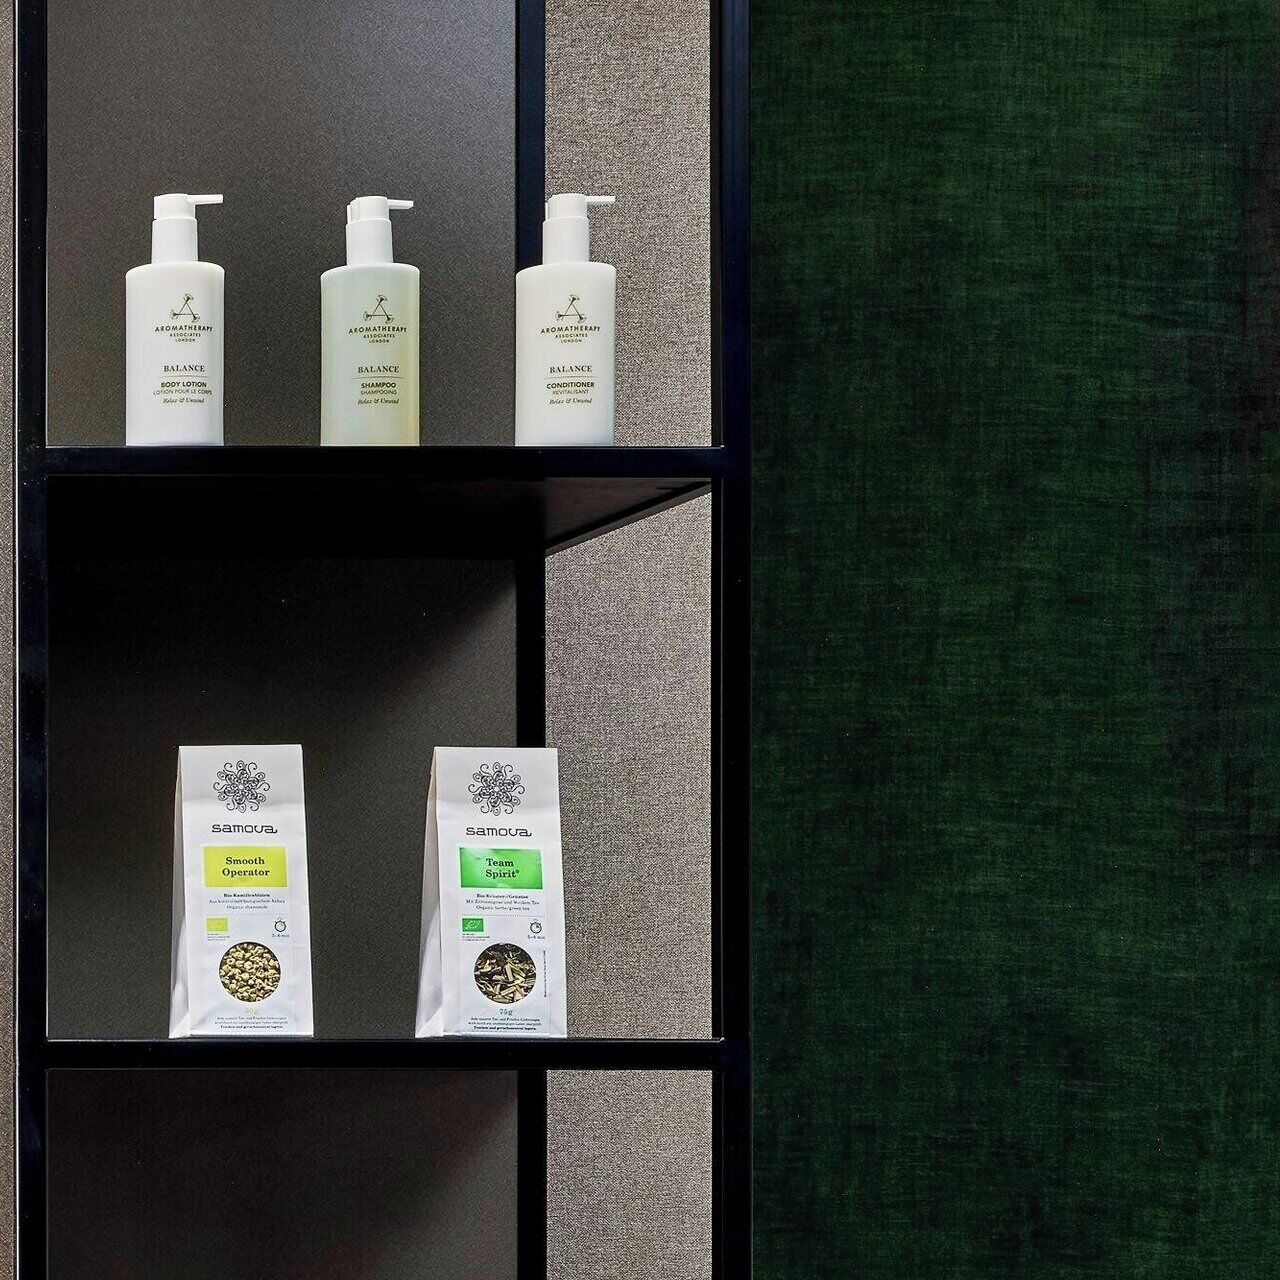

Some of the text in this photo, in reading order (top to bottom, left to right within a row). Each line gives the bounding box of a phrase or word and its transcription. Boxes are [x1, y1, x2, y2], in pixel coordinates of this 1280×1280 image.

[549, 365, 593, 373] BALANCE
[546, 381, 595, 389] CONDITIONER
[211, 823, 278, 834] samova
[466, 826, 532, 837] samova
[225, 856, 265, 866] Smooth
[486, 857, 514, 867] Team
[222, 868, 270, 878] Operator
